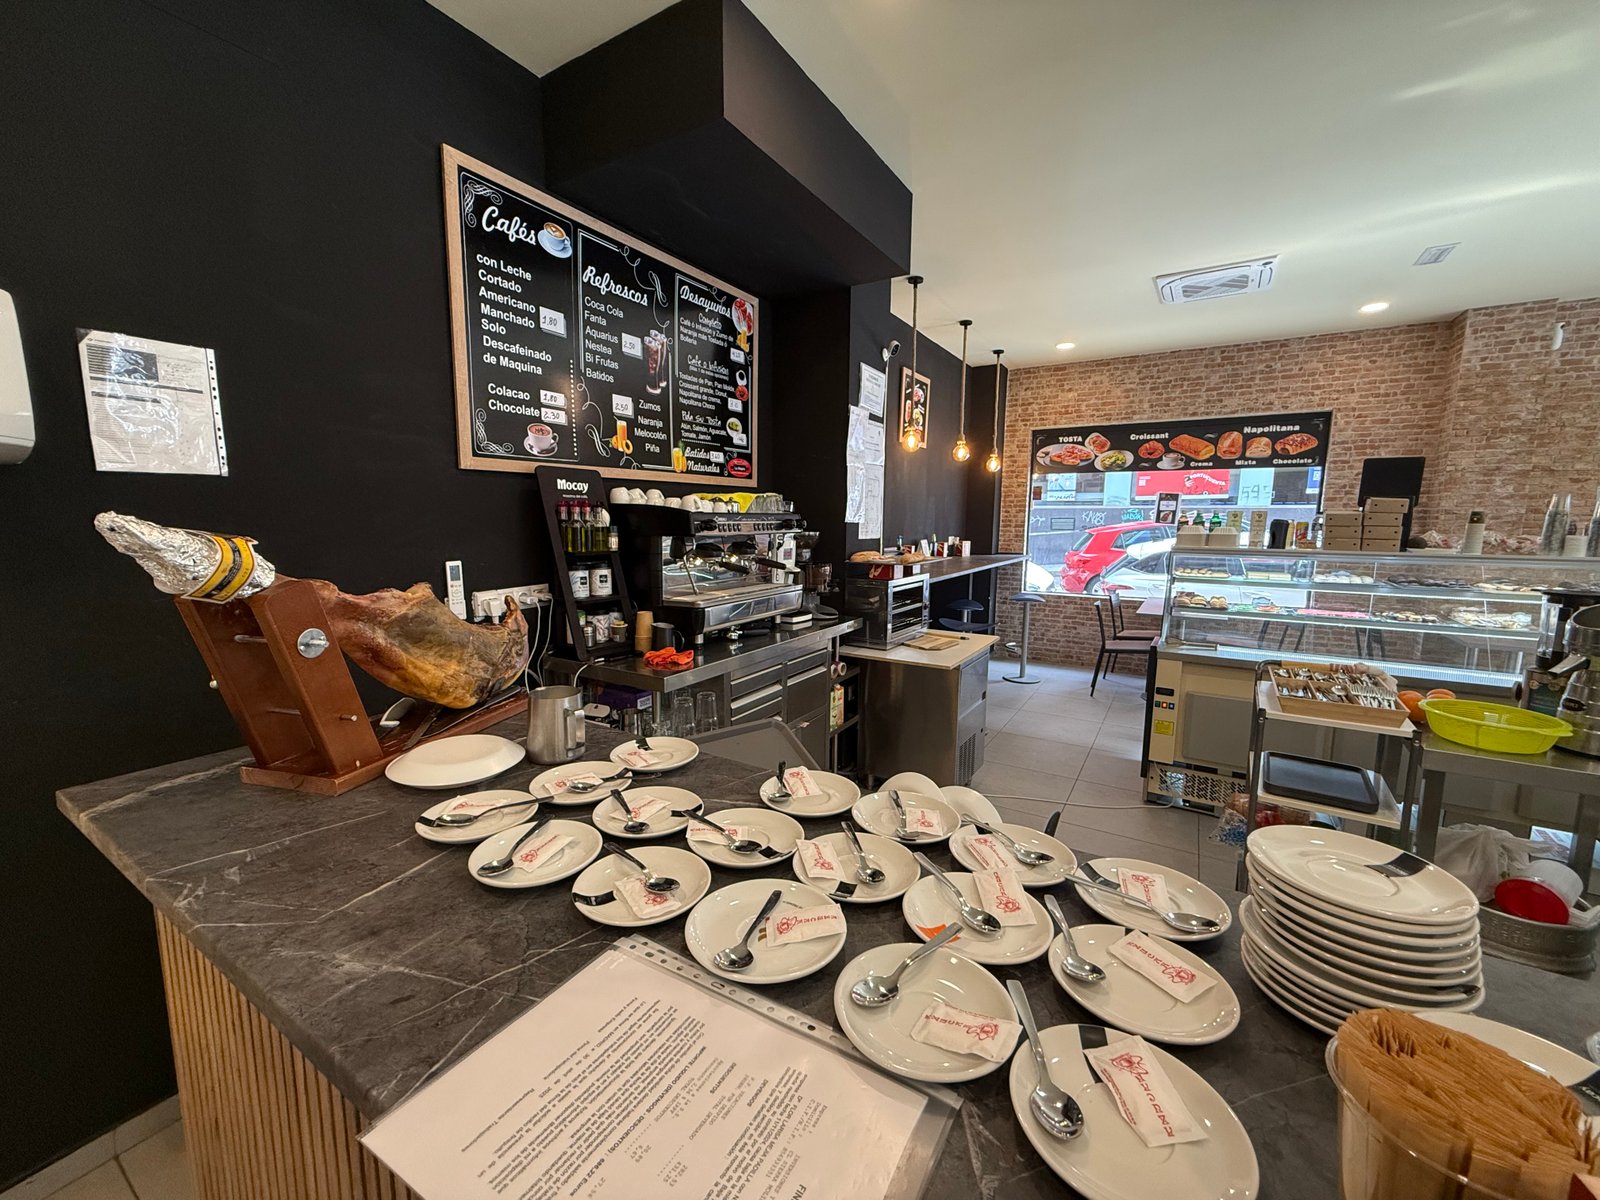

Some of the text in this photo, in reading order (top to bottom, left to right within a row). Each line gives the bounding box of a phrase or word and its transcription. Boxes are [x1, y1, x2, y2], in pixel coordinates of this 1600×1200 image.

[482, 206, 536, 246] Cafés
[476, 254, 532, 281] con Leche
[478, 269, 522, 293] Cortado
[582, 265, 648, 307] Refrescos
[478, 286, 536, 314] Americano
[584, 296, 624, 319] Coca Cola
[680, 285, 732, 319] Desayunos
[480, 302, 536, 329] Manchado
[584, 310, 607, 326] Fanta
[480, 318, 506, 335] Solo
[585, 326, 618, 344] Aquarius
[482, 335, 552, 362] Descafeinado
[585, 339, 612, 355] Nestea
[483, 352, 543, 376] de Maquina
[585, 353, 619, 370] Bi Frutas
[586, 368, 614, 383] Batidos
[488, 382, 530, 401] Colacao
[488, 399, 540, 417] Chocolate
[638, 400, 662, 412] Zumos
[638, 415, 663, 429] Naranja
[1243, 424, 1300, 434] Napolitana
[634, 427, 668, 441] Melocotón
[1130, 432, 1169, 440] Croissant
[645, 443, 660, 453] Piña
[685, 446, 710, 460] Batidos
[688, 460, 720, 473] Naturales
[556, 478, 588, 494] Mocay
[671, 1065, 690, 1085] LIQUIDO
[709, 1062, 737, 1094] DESCUENTOS
[645, 1083, 673, 1114] (DEVENGOS
[746, 1079, 769, 1107] DEVENGOS
[785, 1104, 798, 1120] FLOR
[607, 1115, 645, 1154] DESCUENTOS)
[747, 1133, 754, 1141] en
[772, 1119, 788, 1140] LARISA
[750, 1138, 759, 1149] por
[749, 1146, 762, 1162] causa
[719, 1154, 739, 1180] momento
[732, 1156, 747, 1174] motivo
[740, 1162, 752, 1175] baja
[744, 1157, 764, 1183] PADILLA
[569, 1177, 588, 1197] Euros
[725, 1174, 734, 1184] de
[734, 1174, 742, 1183] en
[715, 1184, 728, 1198] Baja
[736, 1182, 746, 1194] con
[790, 1184, 807, 1200] FIN
